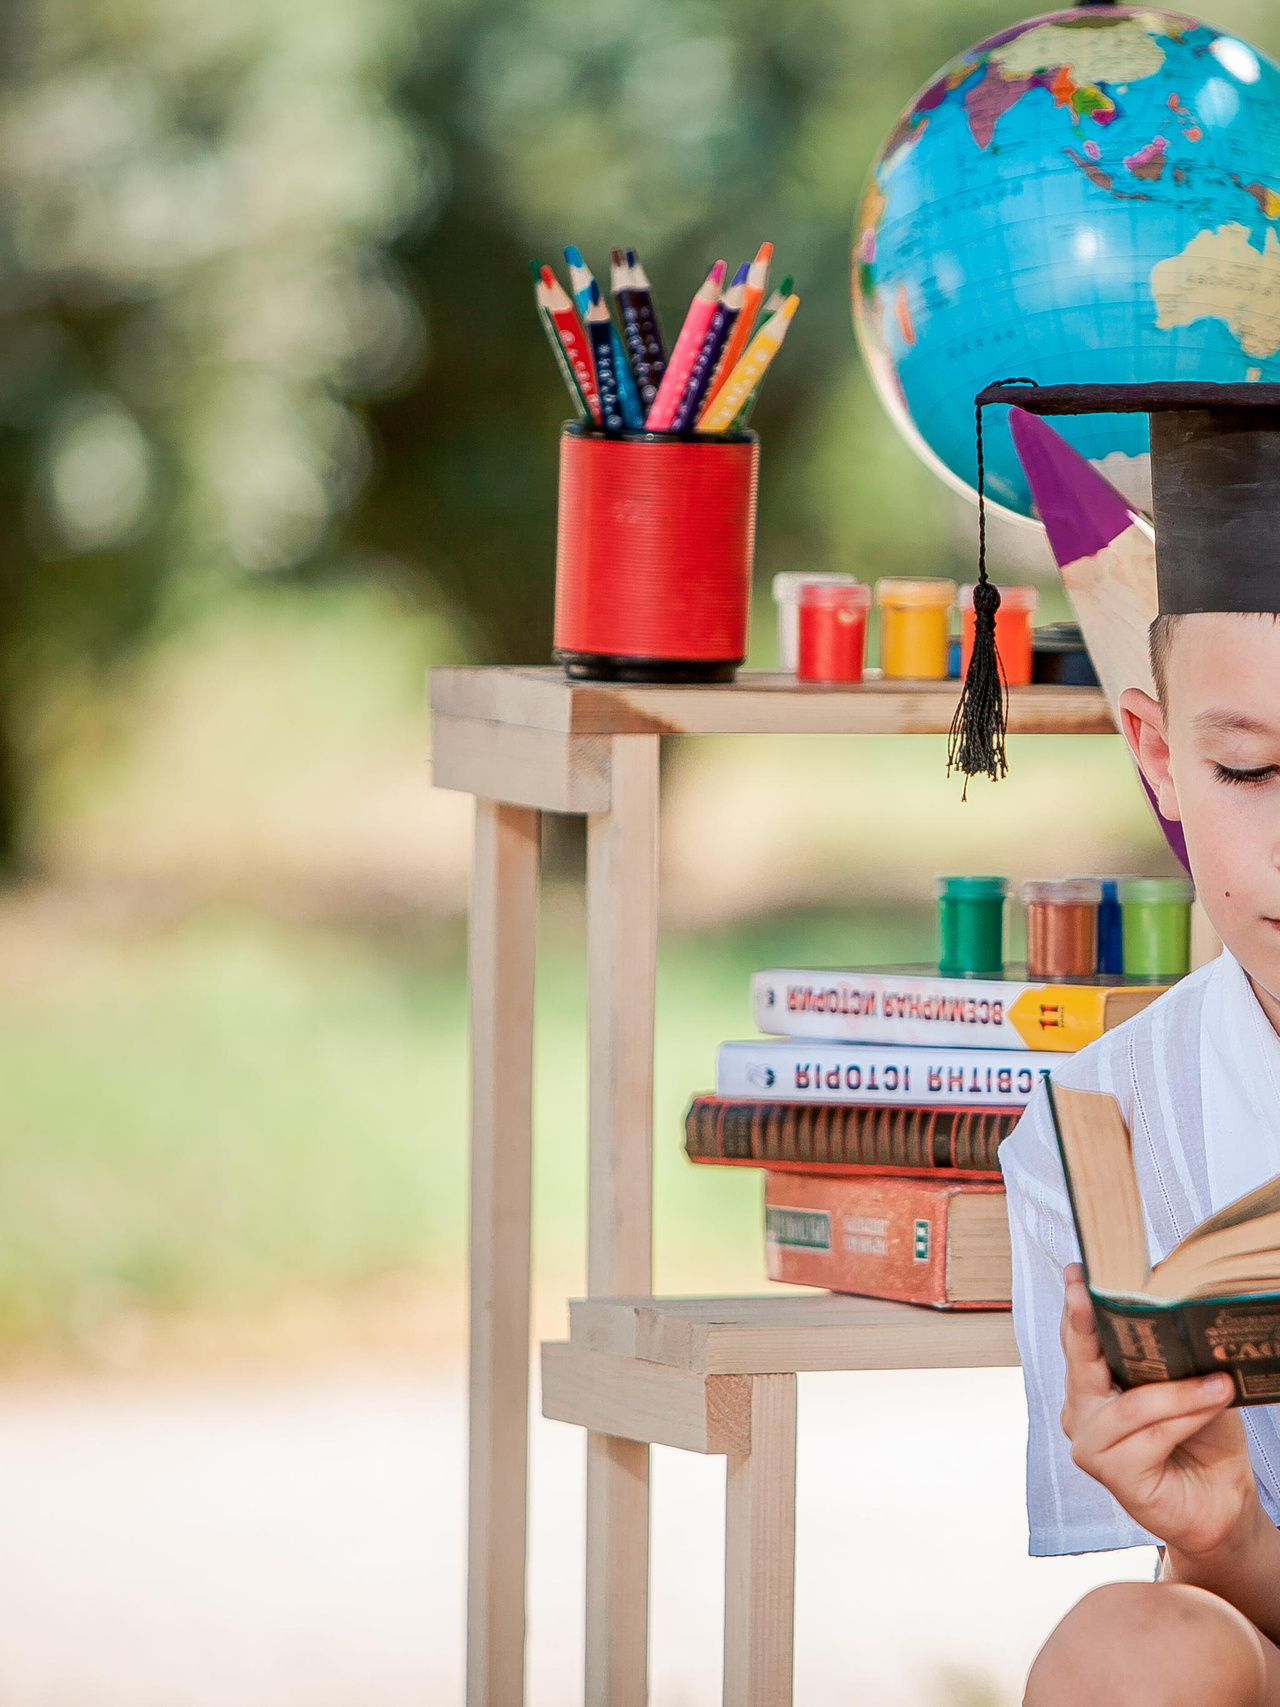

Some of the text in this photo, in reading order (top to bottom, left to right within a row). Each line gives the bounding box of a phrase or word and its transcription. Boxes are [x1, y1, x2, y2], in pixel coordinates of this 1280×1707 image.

[786, 984, 1003, 1026] ВСЕМИРНАЯ ИСТОРИЯ
[1039, 1003, 1059, 1031] 11
[795, 1063, 910, 1092] ІСТОРІЯ
